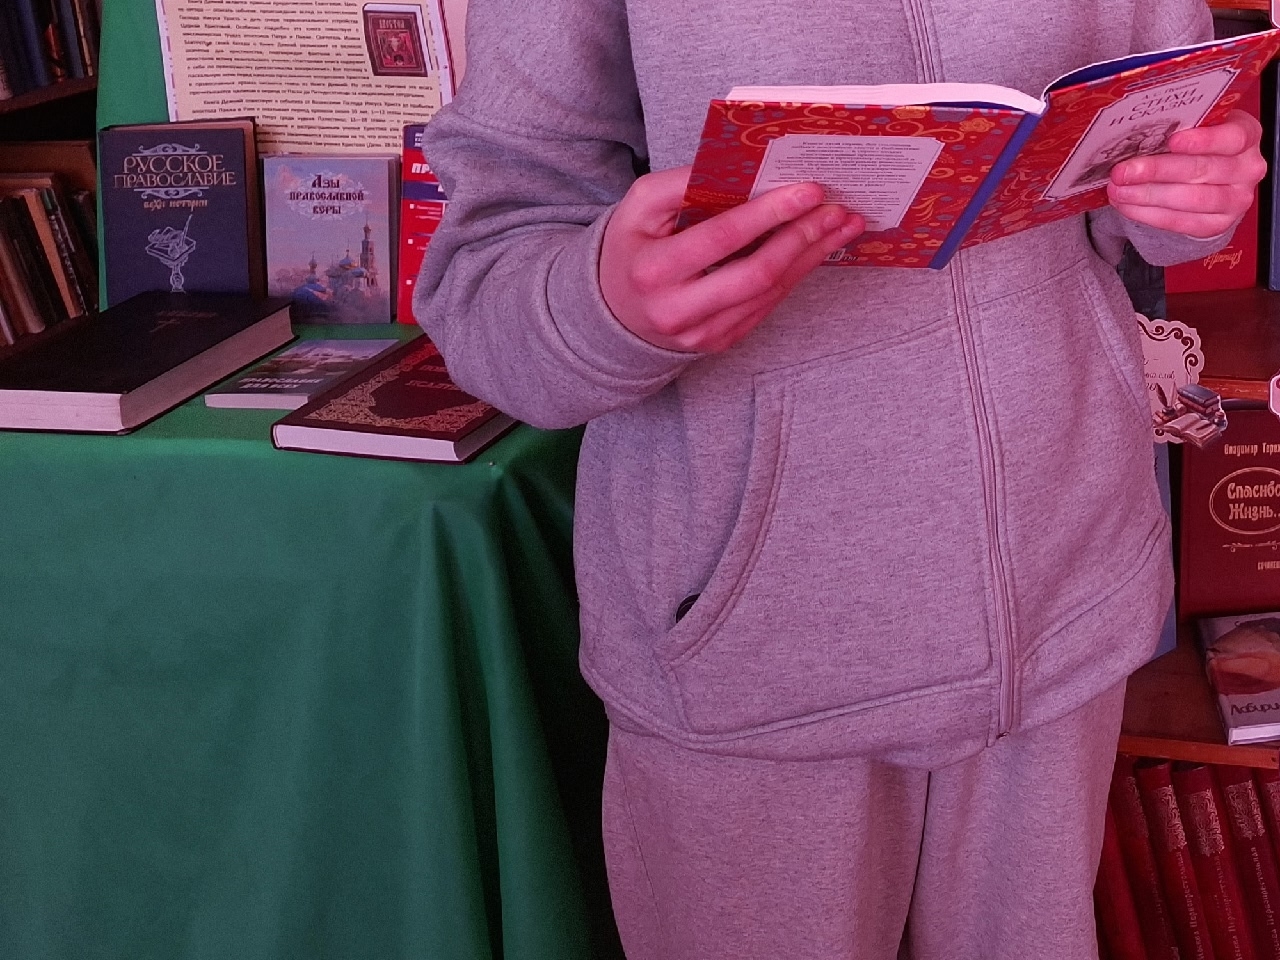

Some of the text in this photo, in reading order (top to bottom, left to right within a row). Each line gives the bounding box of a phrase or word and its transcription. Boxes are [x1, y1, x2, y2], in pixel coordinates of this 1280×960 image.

[1132, 89, 1197, 112] СТИХИ
[1110, 95, 1204, 126] И СКАЗКИ
[124, 154, 224, 174] РУССКОЕ
[114, 171, 236, 189] ПРАВОСЛАВИЕ
[312, 174, 340, 189] Азы
[289, 189, 365, 202] православной
[312, 203, 341, 215] веры
[1224, 444, 1258, 456] Владимир
